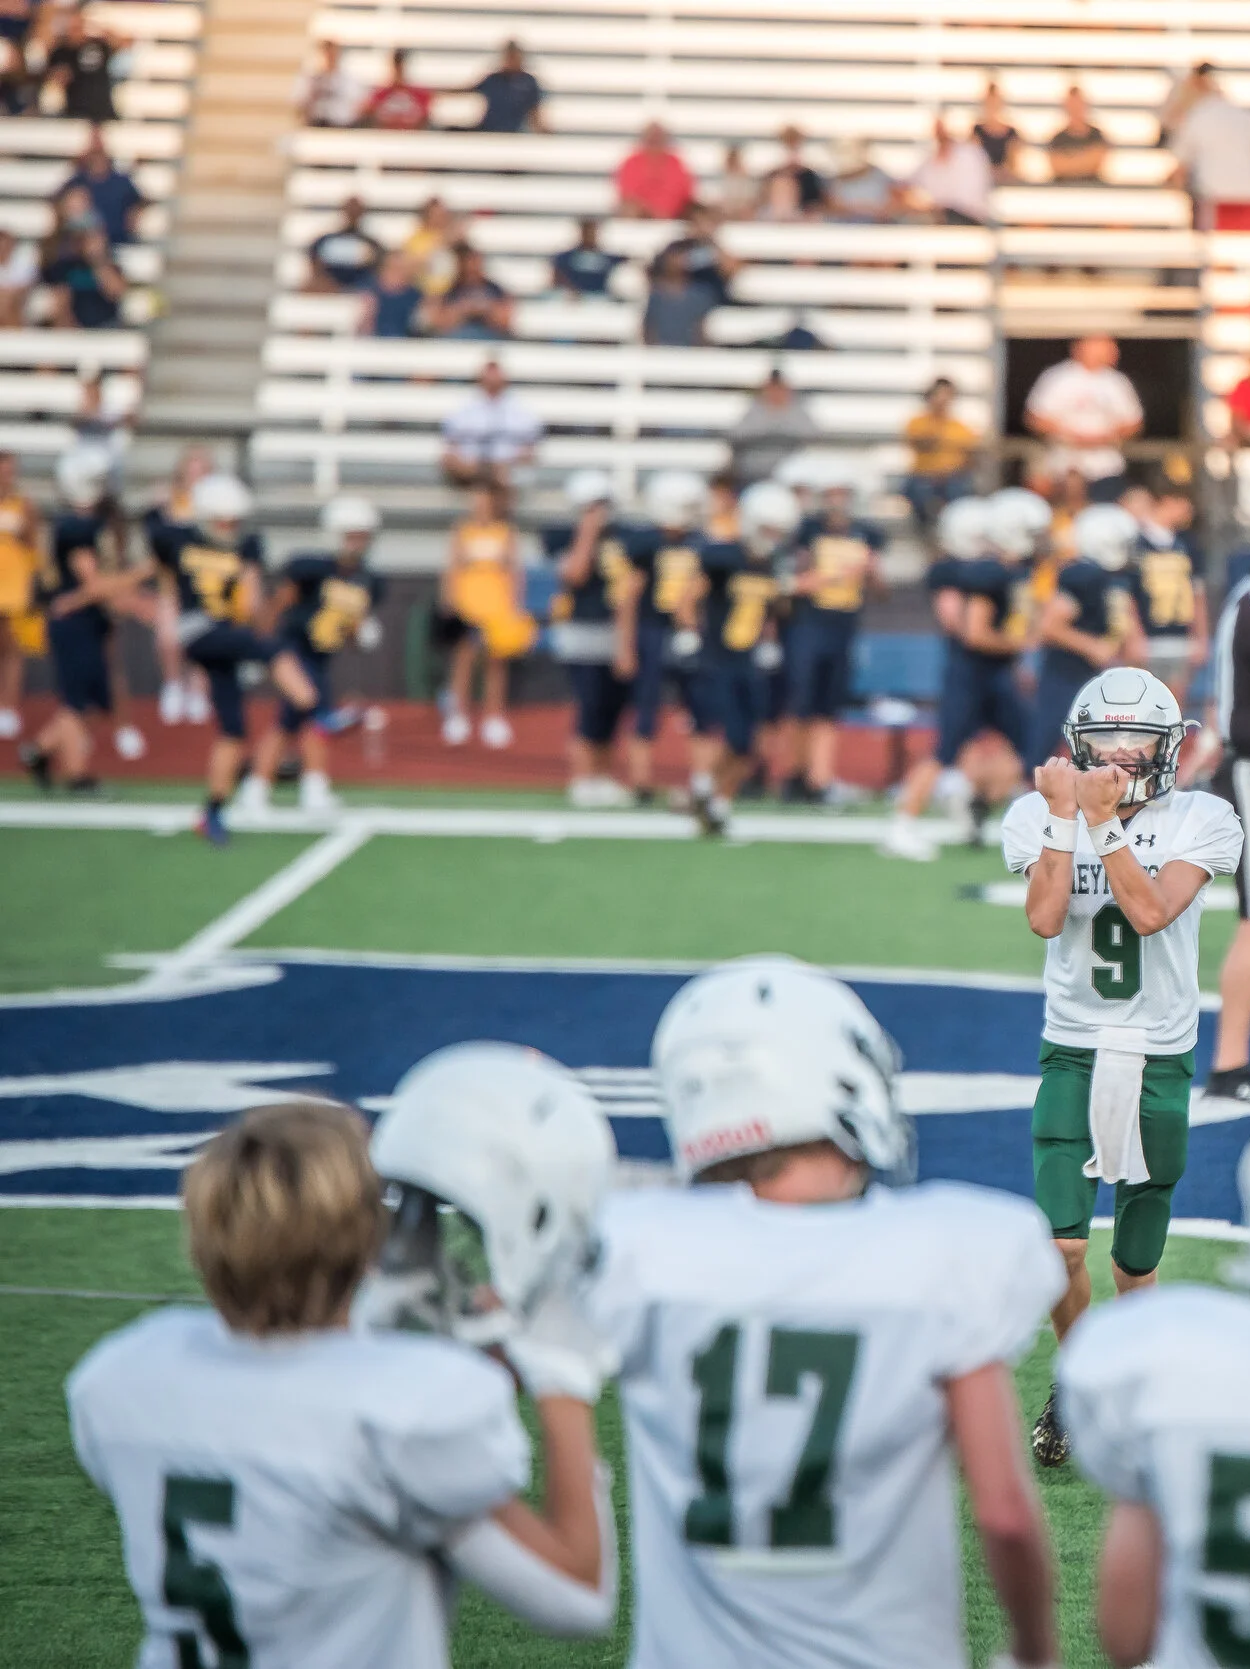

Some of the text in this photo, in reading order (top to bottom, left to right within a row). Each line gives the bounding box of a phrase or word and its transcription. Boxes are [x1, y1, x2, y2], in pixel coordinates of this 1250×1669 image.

[1092, 904, 1142, 1000] 9
[684, 1322, 862, 1547] 17
[162, 1475, 249, 1669] 5
